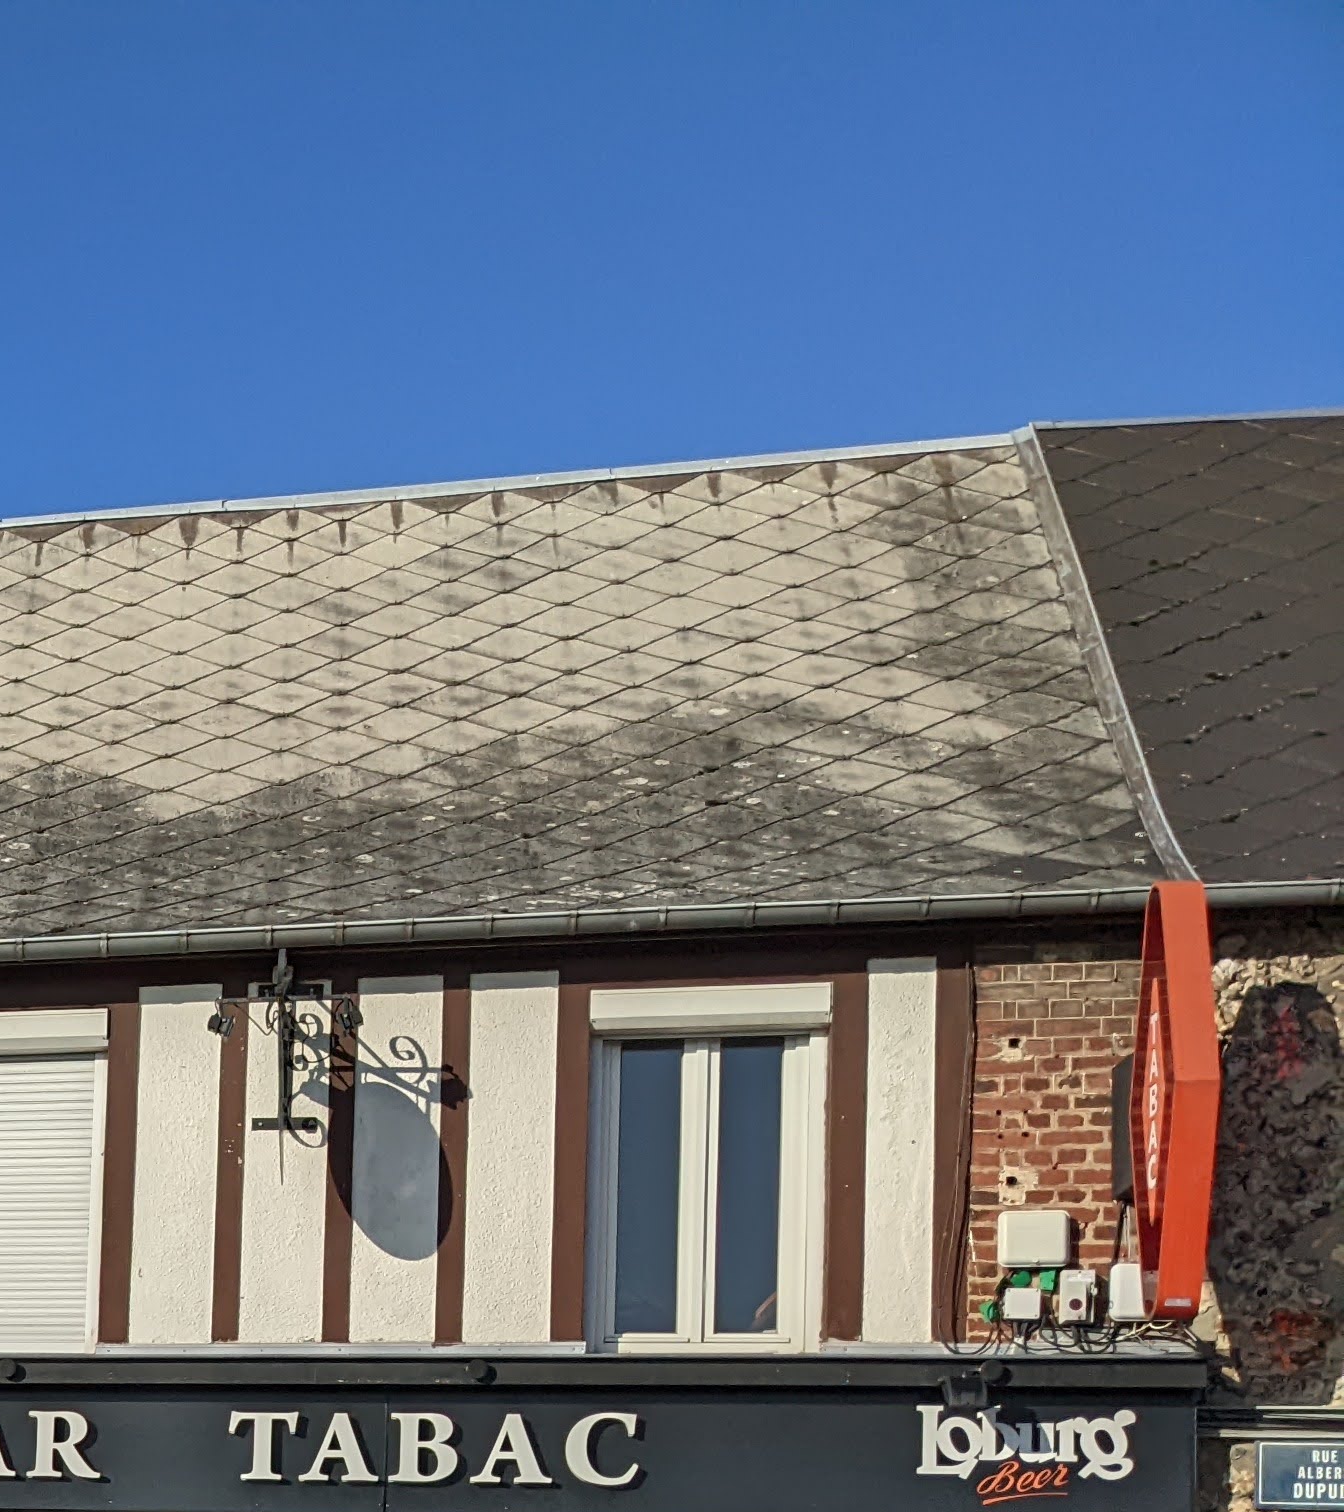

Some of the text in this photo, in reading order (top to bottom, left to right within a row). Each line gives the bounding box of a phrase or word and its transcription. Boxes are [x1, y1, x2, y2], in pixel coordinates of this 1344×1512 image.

[1146, 1011, 1159, 1191] TABAC
[229, 1410, 640, 1486] TABAC
[916, 1404, 1137, 1481] Loburg
[1312, 1450, 1338, 1463] RUE
[976, 1460, 1069, 1496] Beer
[1298, 1466, 1344, 1480] ALBER
